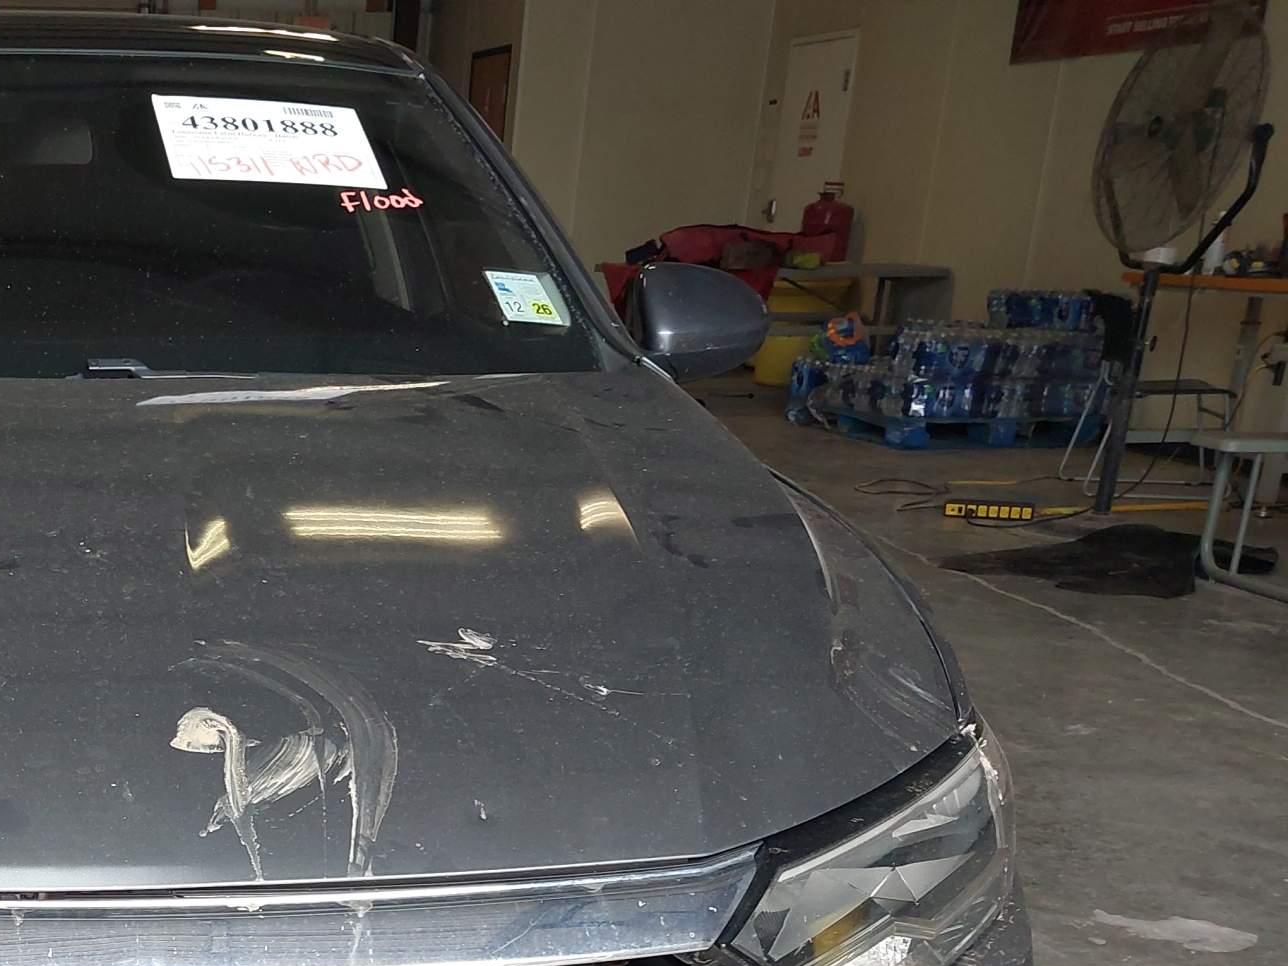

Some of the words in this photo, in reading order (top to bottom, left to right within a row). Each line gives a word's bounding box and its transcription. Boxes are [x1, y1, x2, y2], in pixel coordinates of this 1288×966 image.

[182, 115, 339, 137] 43801888
[340, 188, 424, 213] Flood
[505, 301, 525, 313] 12
[532, 303, 553, 315] 26
